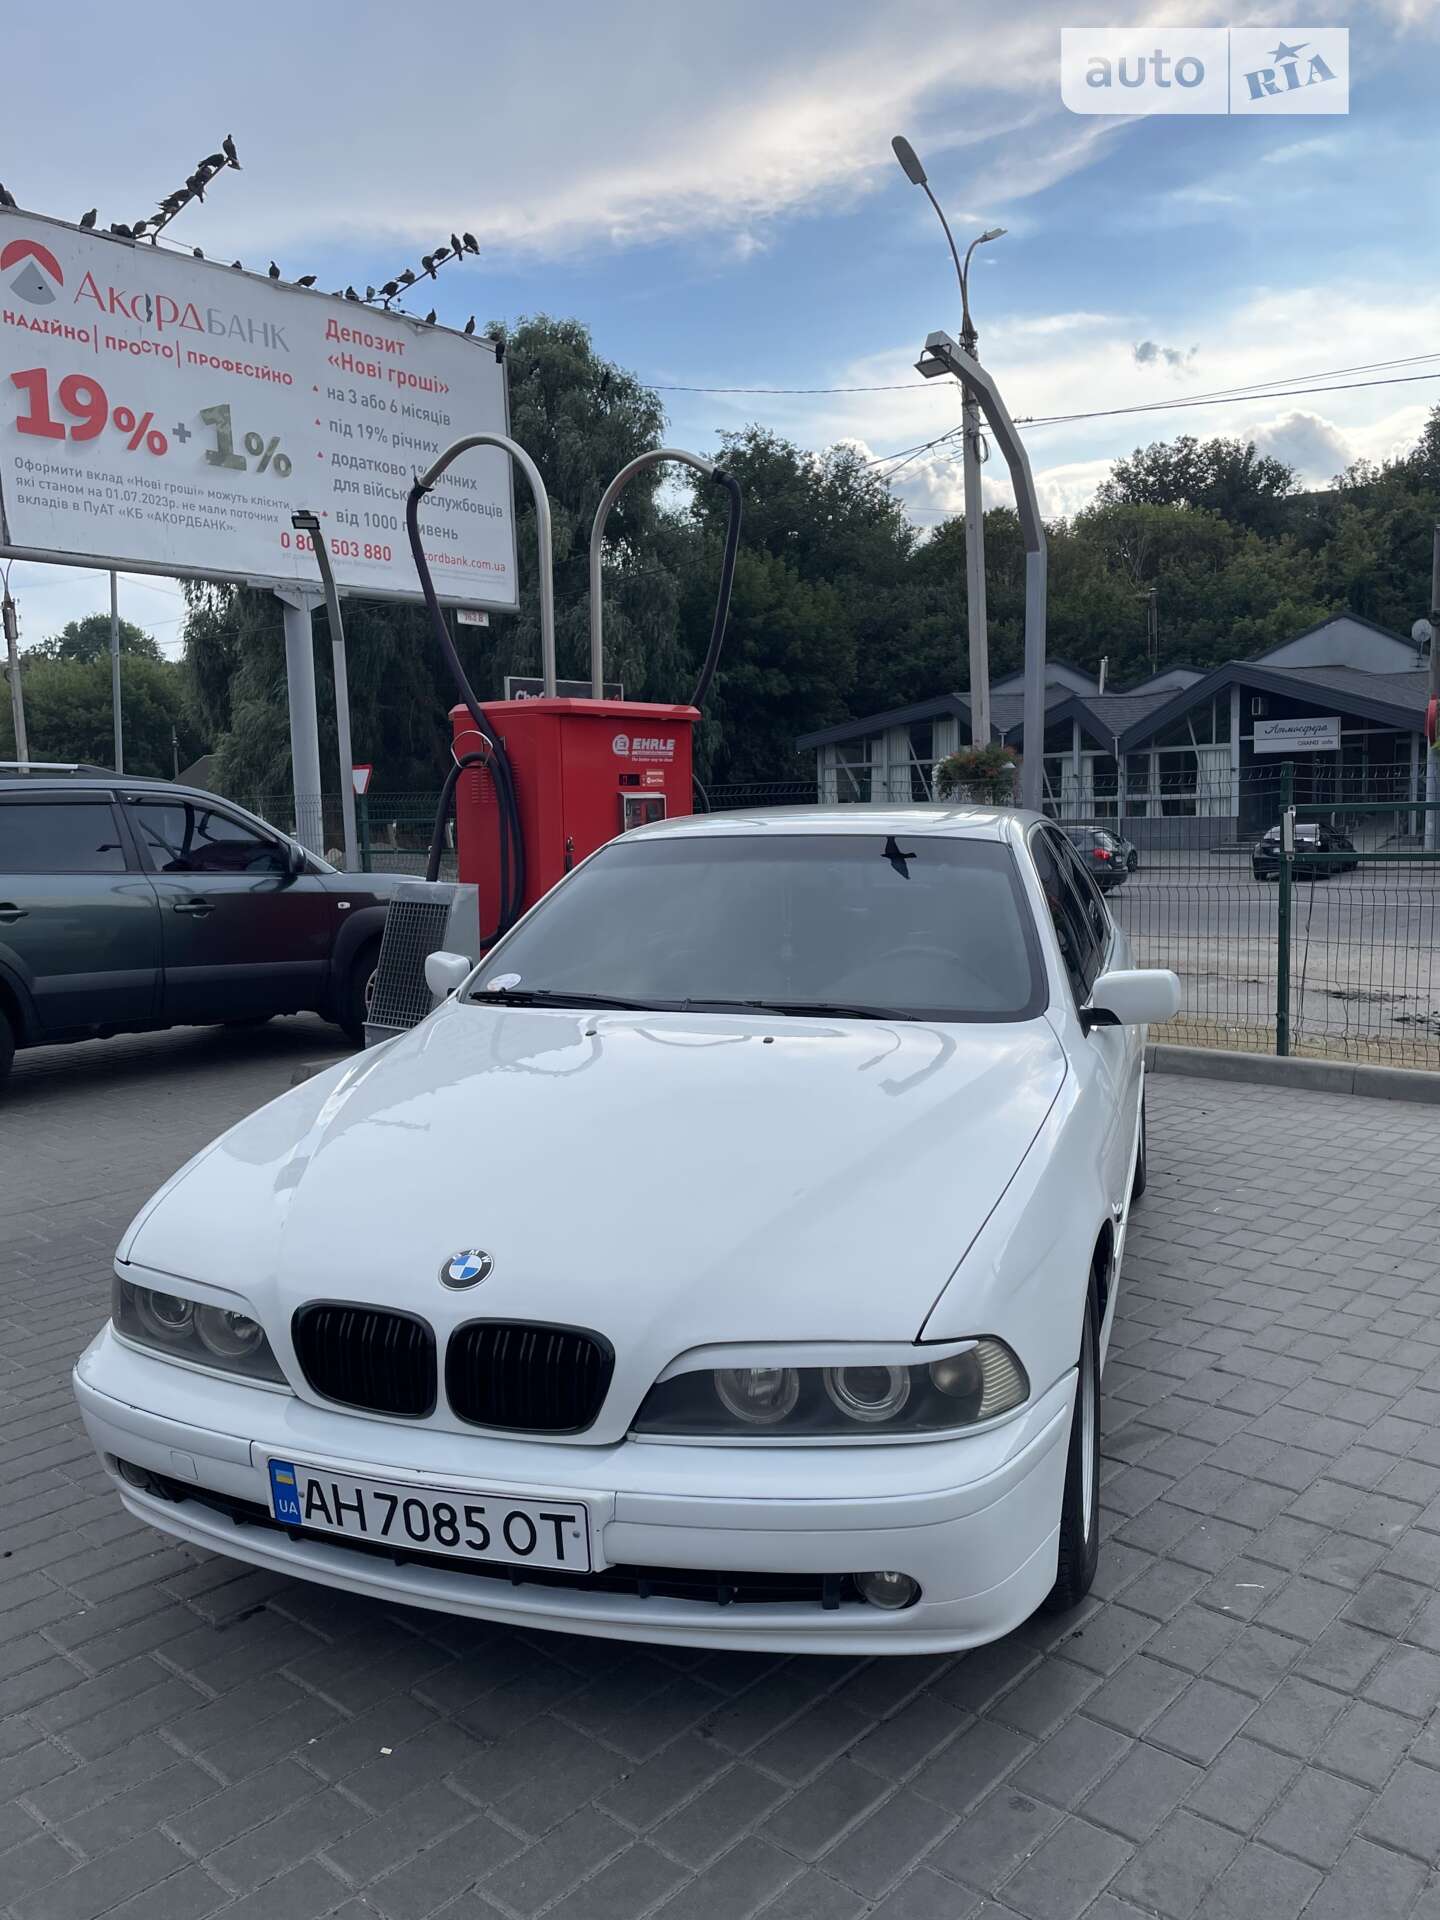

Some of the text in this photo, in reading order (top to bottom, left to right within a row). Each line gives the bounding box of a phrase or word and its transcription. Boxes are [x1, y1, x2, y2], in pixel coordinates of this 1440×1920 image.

[3, 310, 293, 386] НАДІЙНО ПРОСТО ПРОФЕСІЙНО
[325, 318, 406, 356] Депозит
[328, 352, 450, 394] «Нові гроші»
[10, 367, 169, 456] 19%
[199, 404, 292, 477] 1%
[327, 386, 451, 427] на 3 або 6 місяців
[329, 419, 439, 454] під 19% річних
[14, 456, 83, 477] Оформити
[86, 470, 124, 485] вклад
[127, 475, 161, 489] «Нові
[164, 482, 205, 497] гроші»
[207, 490, 249, 504] можуть
[331, 453, 407, 477] додатково
[17, 495, 69, 510] вкладів
[72, 502, 80, 511] в
[84, 501, 115, 516] ПуАТ
[119, 507, 144, 520] «КБ
[39, 481, 84, 496] станом
[88, 487, 103, 498] на
[182, 502, 197, 512] не
[199, 504, 228, 516] мали
[230, 509, 279, 523] поточних
[333, 478, 503, 518] для військослужбовців
[336, 508, 360, 528] від
[364, 511, 398, 530] 1000
[281, 532, 290, 548] 0
[331, 538, 360, 558] 503
[364, 544, 392, 561] 880
[632, 737, 675, 750] EHRLE
[1265, 722, 1328, 736] Атмосфера
[278, 1499, 298, 1515] UA
